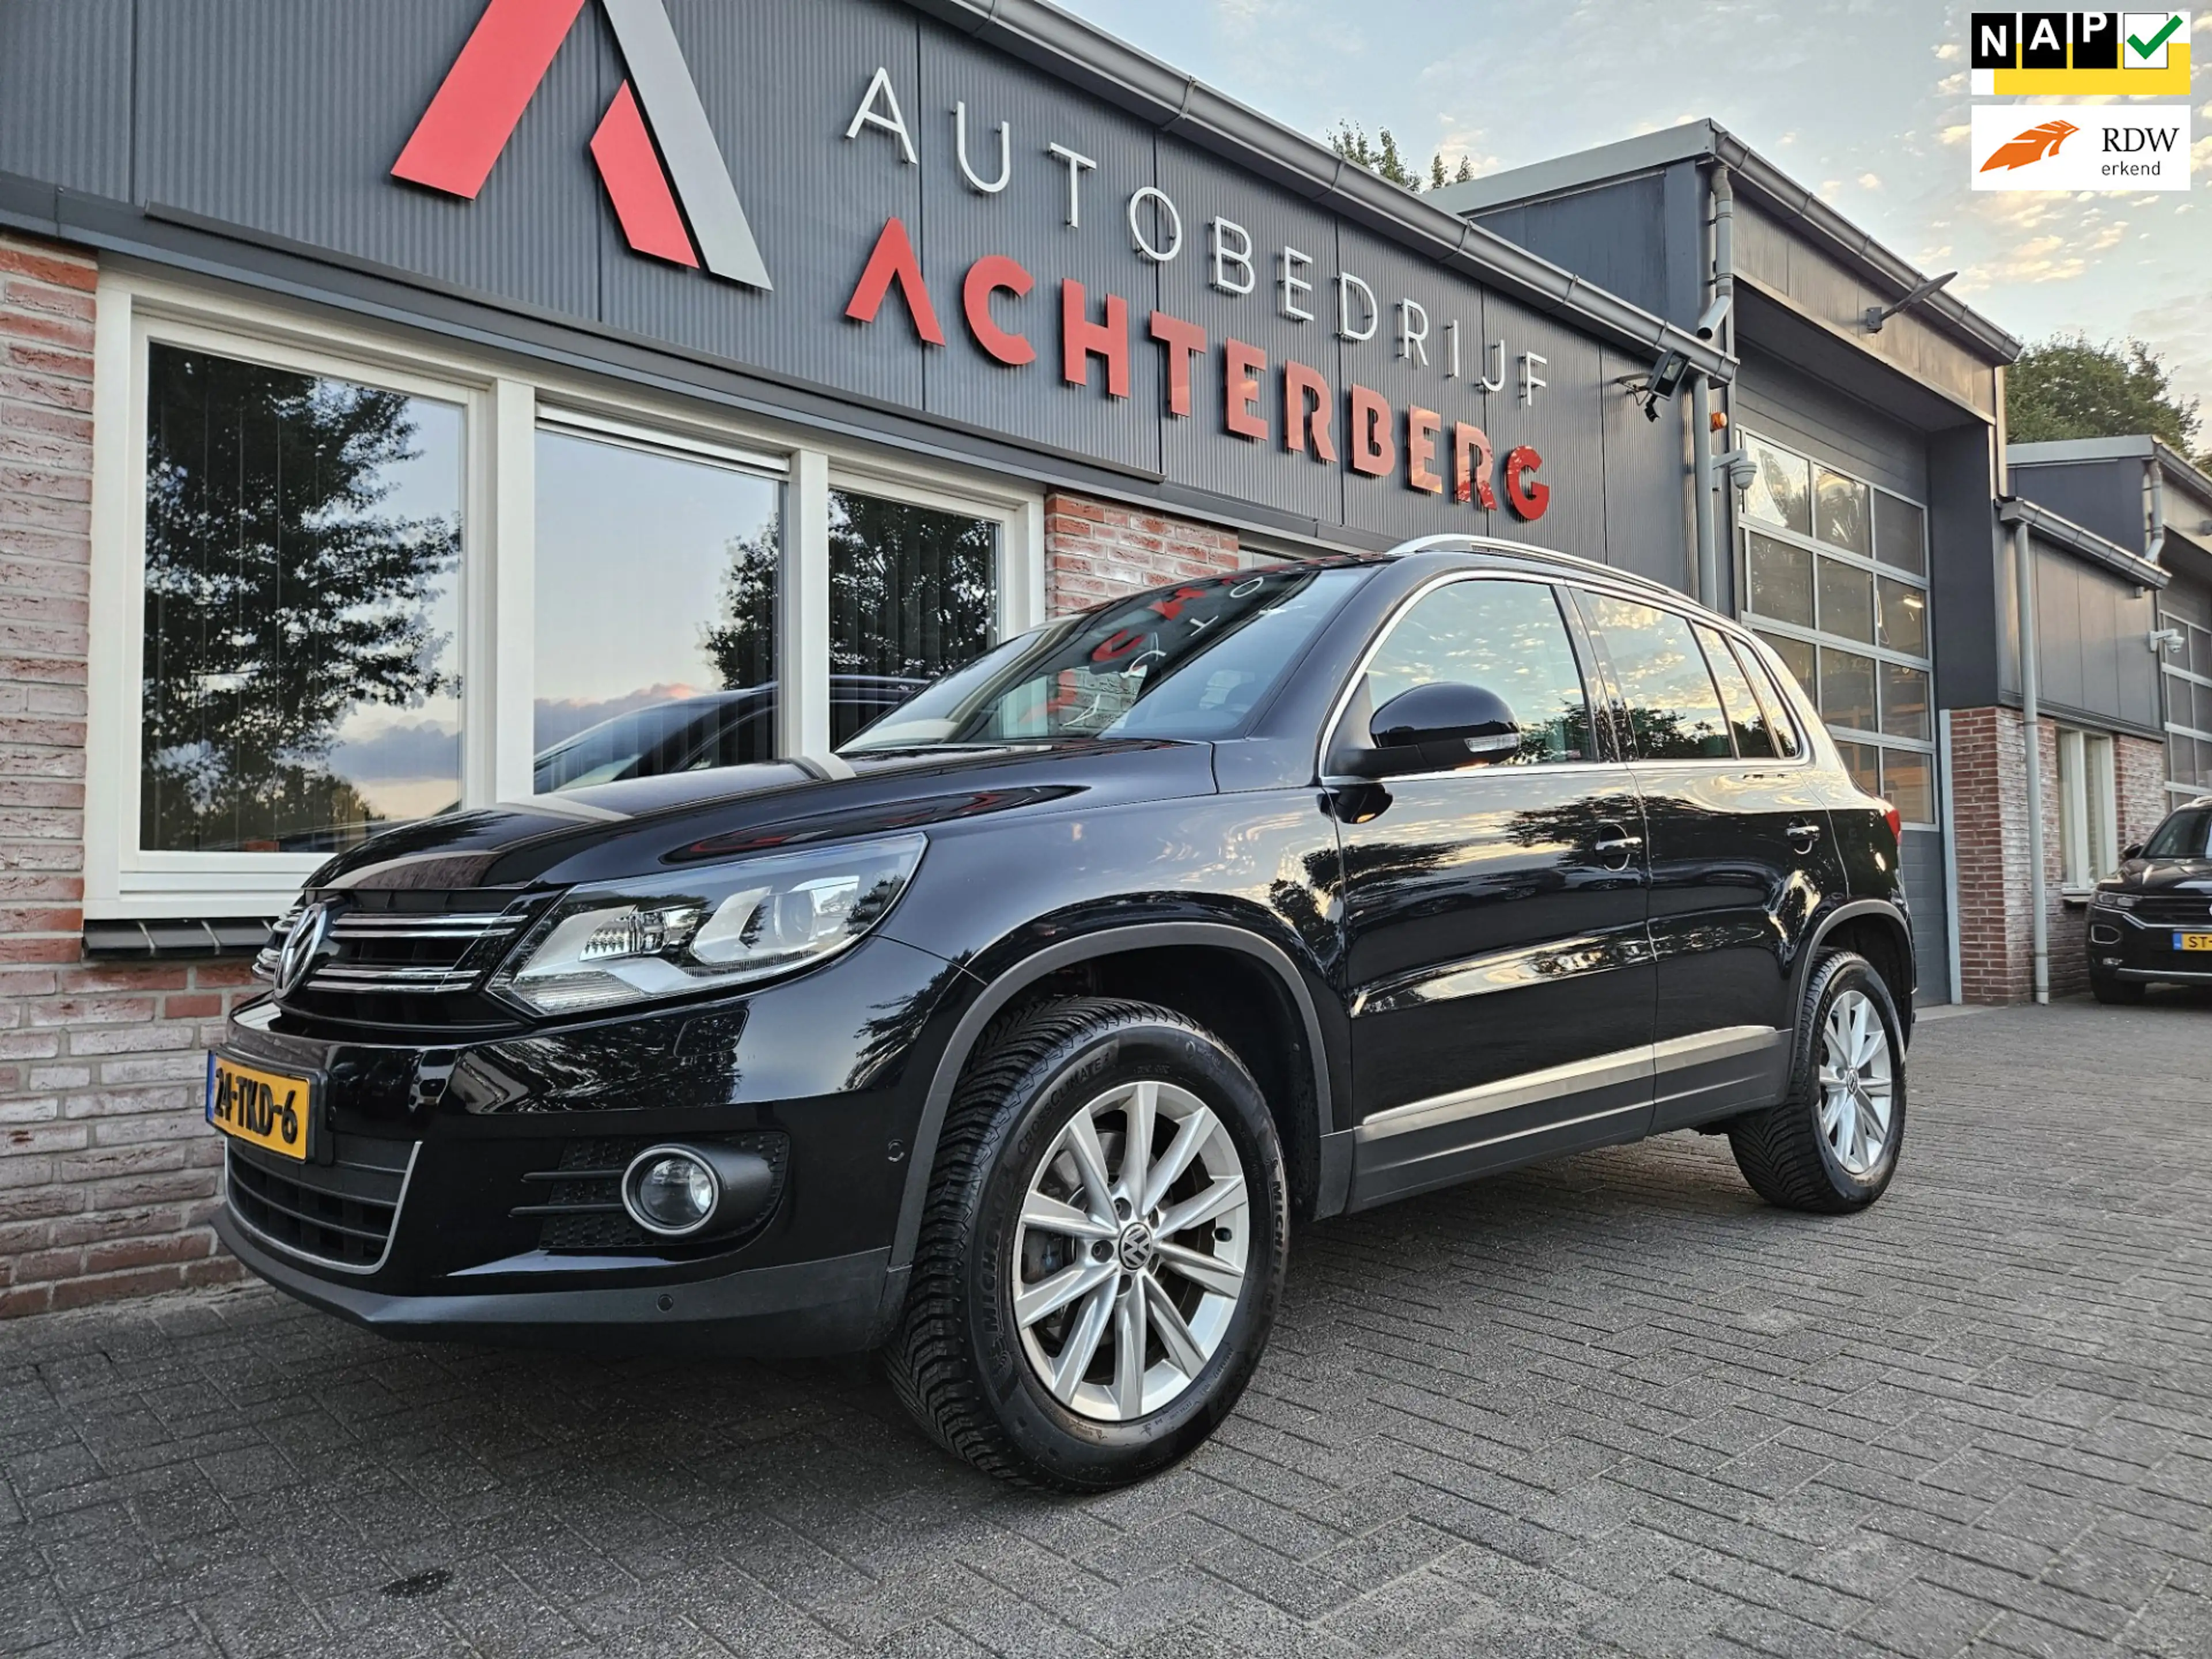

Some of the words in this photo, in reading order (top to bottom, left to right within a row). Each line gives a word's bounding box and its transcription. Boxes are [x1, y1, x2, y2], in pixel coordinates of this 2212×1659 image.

[844, 216, 1550, 521] ACHTERBERG
[845, 66, 1547, 406] AUTOBEDRIJF
[214, 1067, 298, 1145] 24-TKD-6
